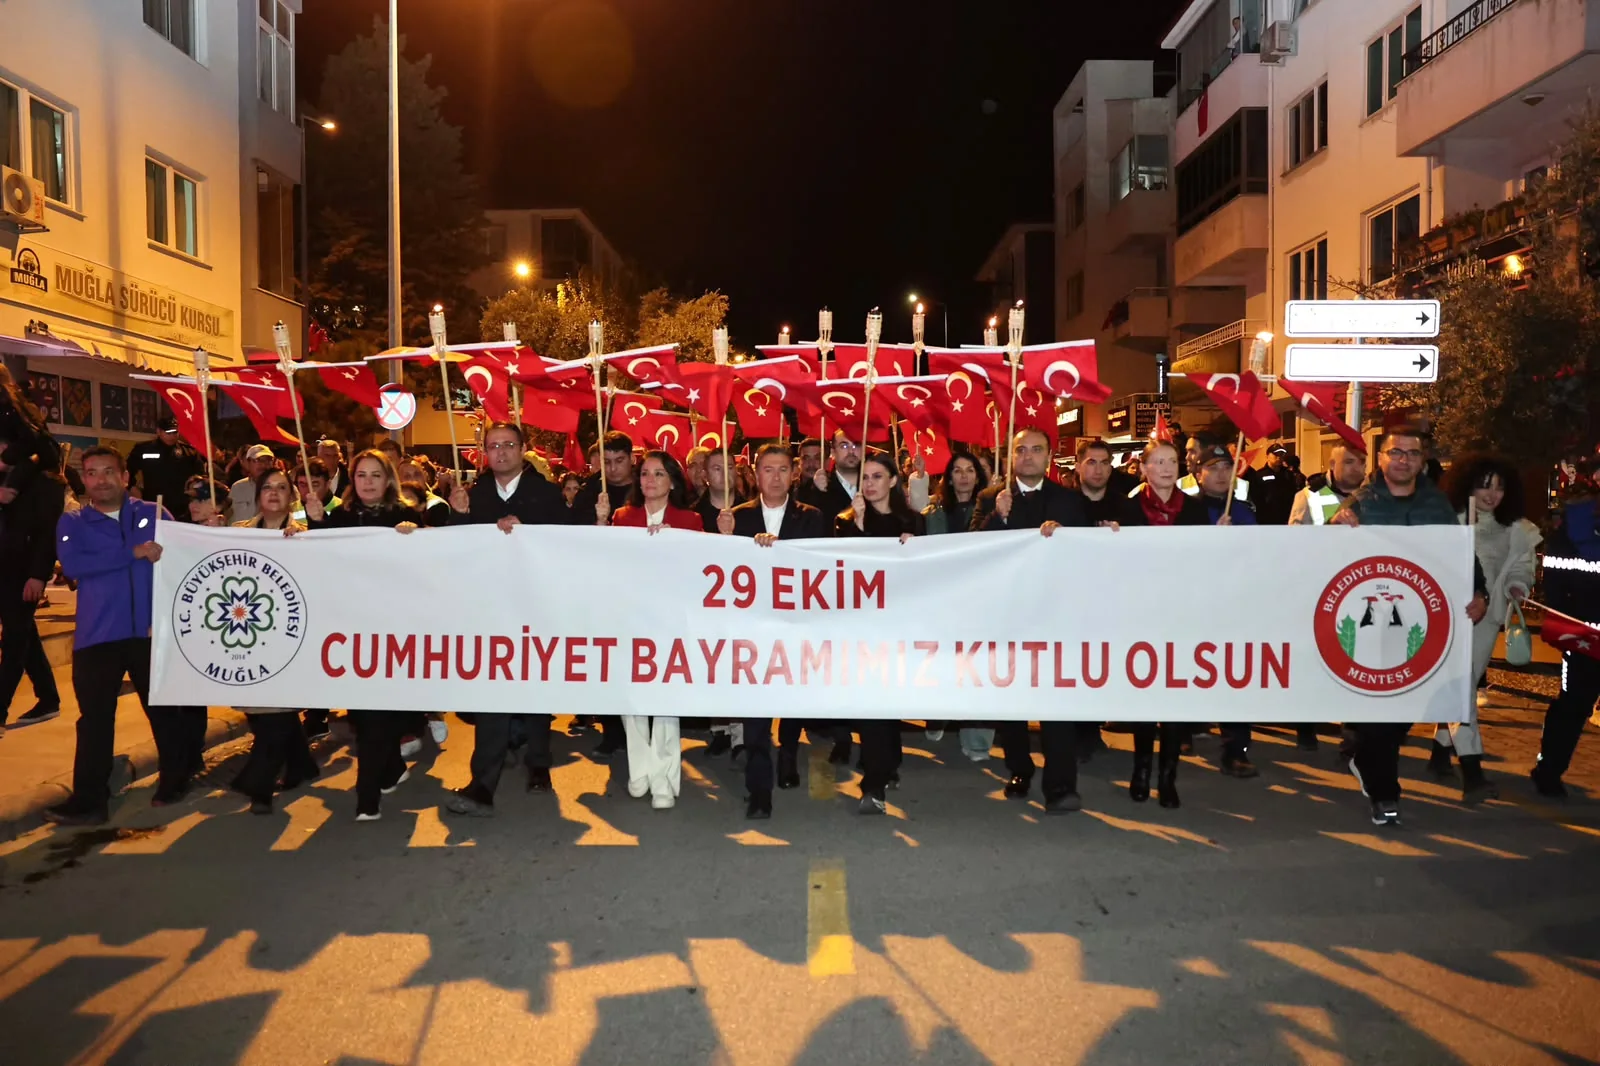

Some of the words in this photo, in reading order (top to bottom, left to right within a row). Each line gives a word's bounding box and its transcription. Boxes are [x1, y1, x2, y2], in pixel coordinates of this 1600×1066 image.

[14, 271, 45, 290] MUĞLA
[55, 264, 116, 306] MUĞLA
[119, 283, 177, 323] SÜRÜCÜ
[180, 305, 220, 337] KURSU
[1136, 402, 1170, 411] GOLDEN
[181, 552, 257, 604] BÜYÜKŞEHİR
[261, 562, 301, 639] BELEDİYESİ
[702, 564, 757, 609] 29
[771, 559, 886, 611] EKİM
[1323, 563, 1373, 613] BELEDİYE
[1376, 563, 1442, 613] BAŞKANLIĞI
[179, 609, 192, 637] T.C.
[204, 662, 270, 683] MUĞLA
[320, 625, 618, 683] CUMHURİYET
[631, 637, 939, 687] BAYRAMIMIZ
[955, 640, 1110, 689] KUTLU
[1125, 640, 1291, 690] OLSUN
[1347, 666, 1413, 684] MENTEŞE
